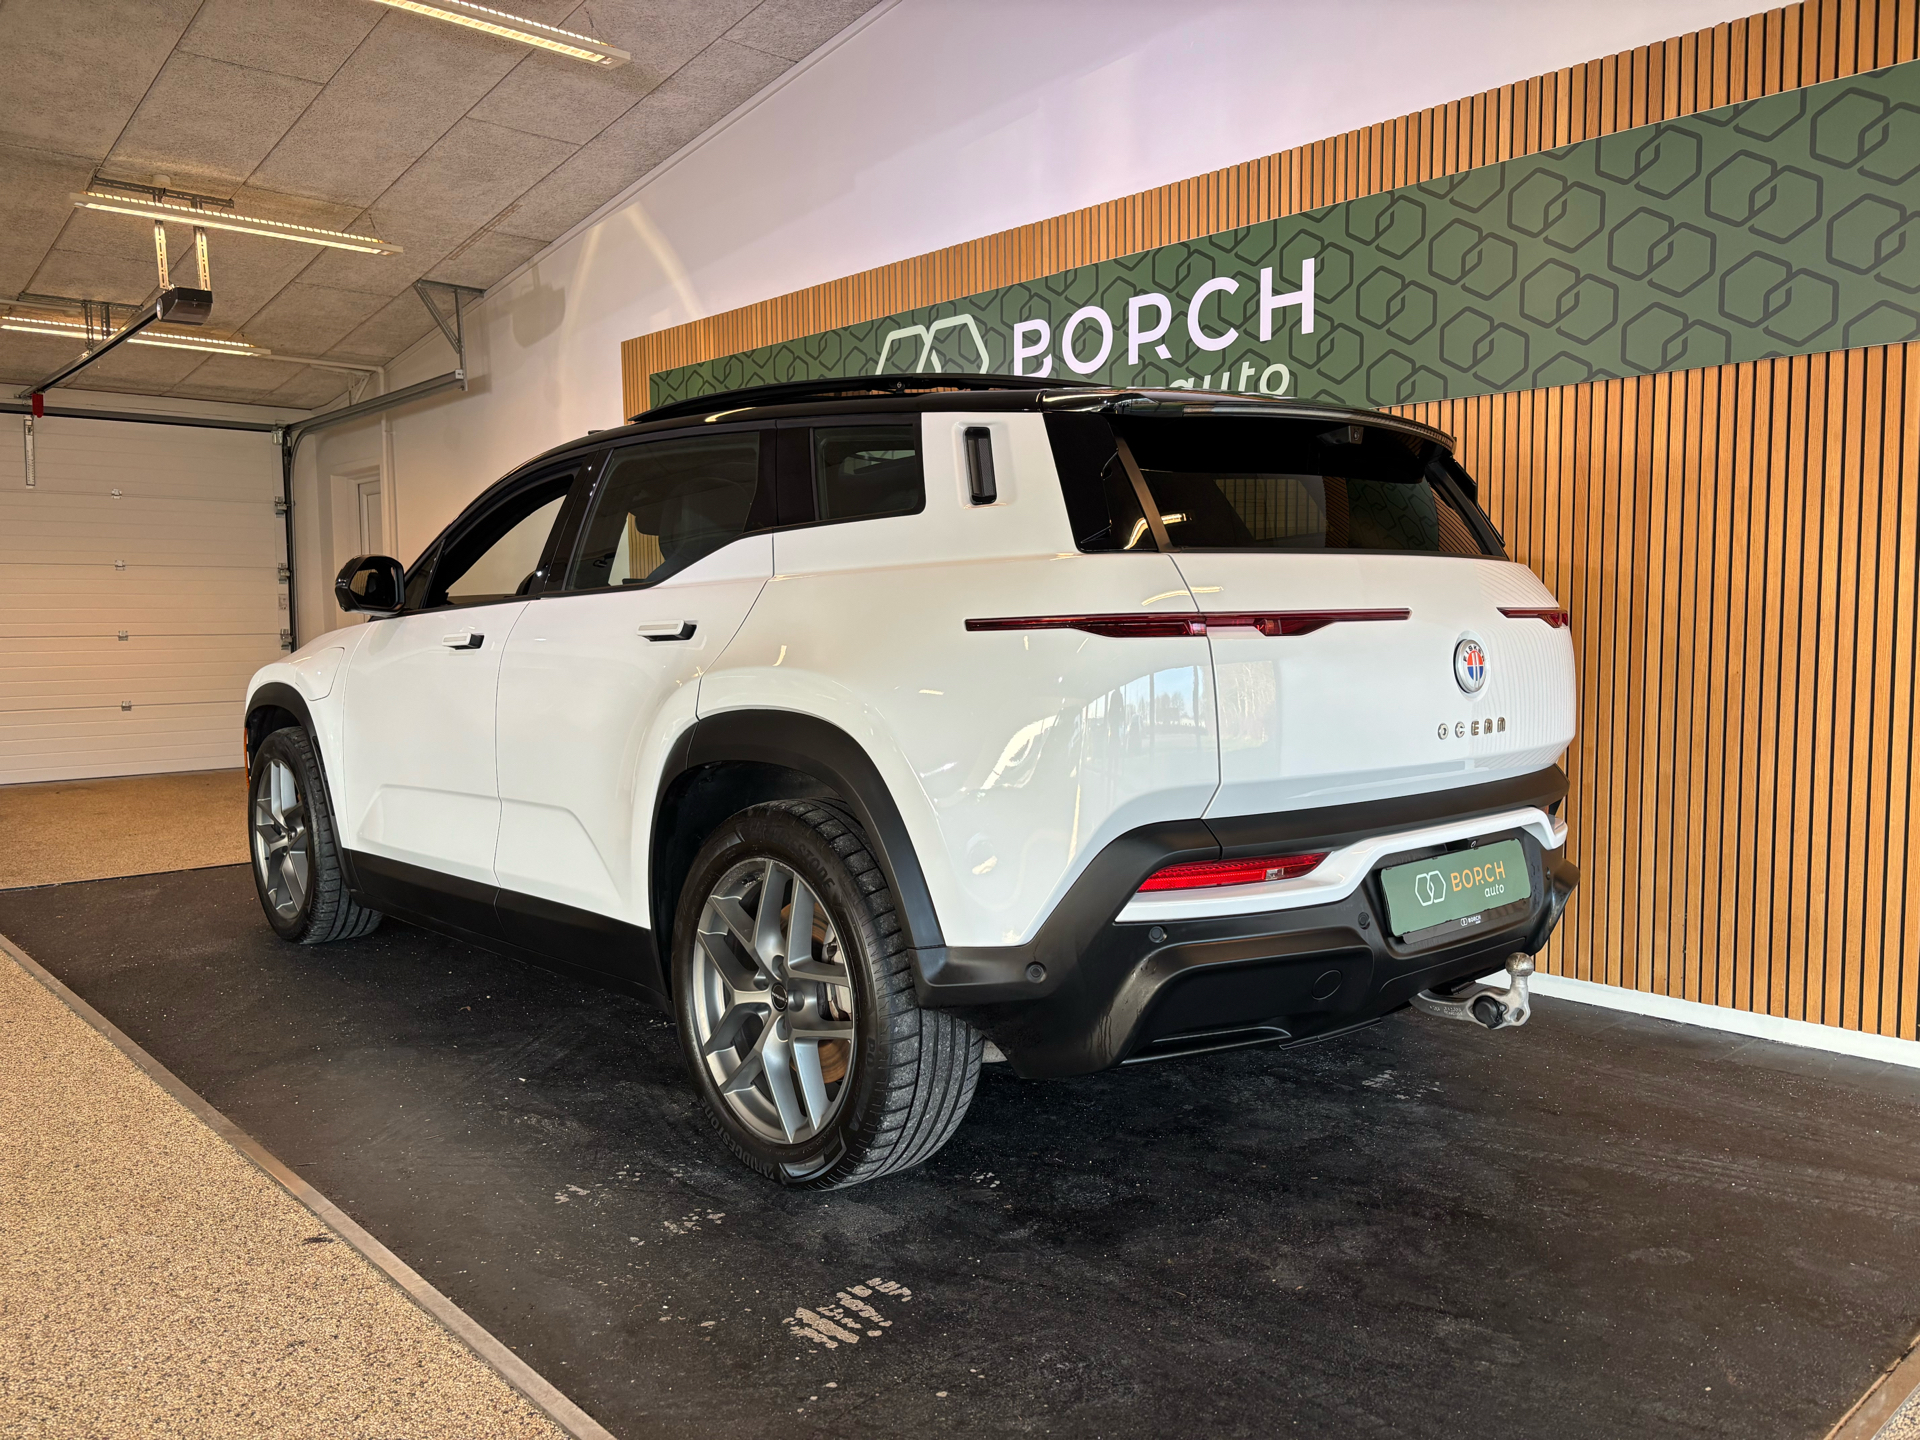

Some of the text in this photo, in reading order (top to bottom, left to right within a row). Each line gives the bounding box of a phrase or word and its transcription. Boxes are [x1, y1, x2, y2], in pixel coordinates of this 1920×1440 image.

[1013, 258, 1315, 378] BORCH
[1437, 716, 1506, 740] OCEAN
[1450, 860, 1506, 892] BORCH
[1484, 884, 1505, 898] auto
[699, 1096, 775, 1180] BRIDGESTONE
